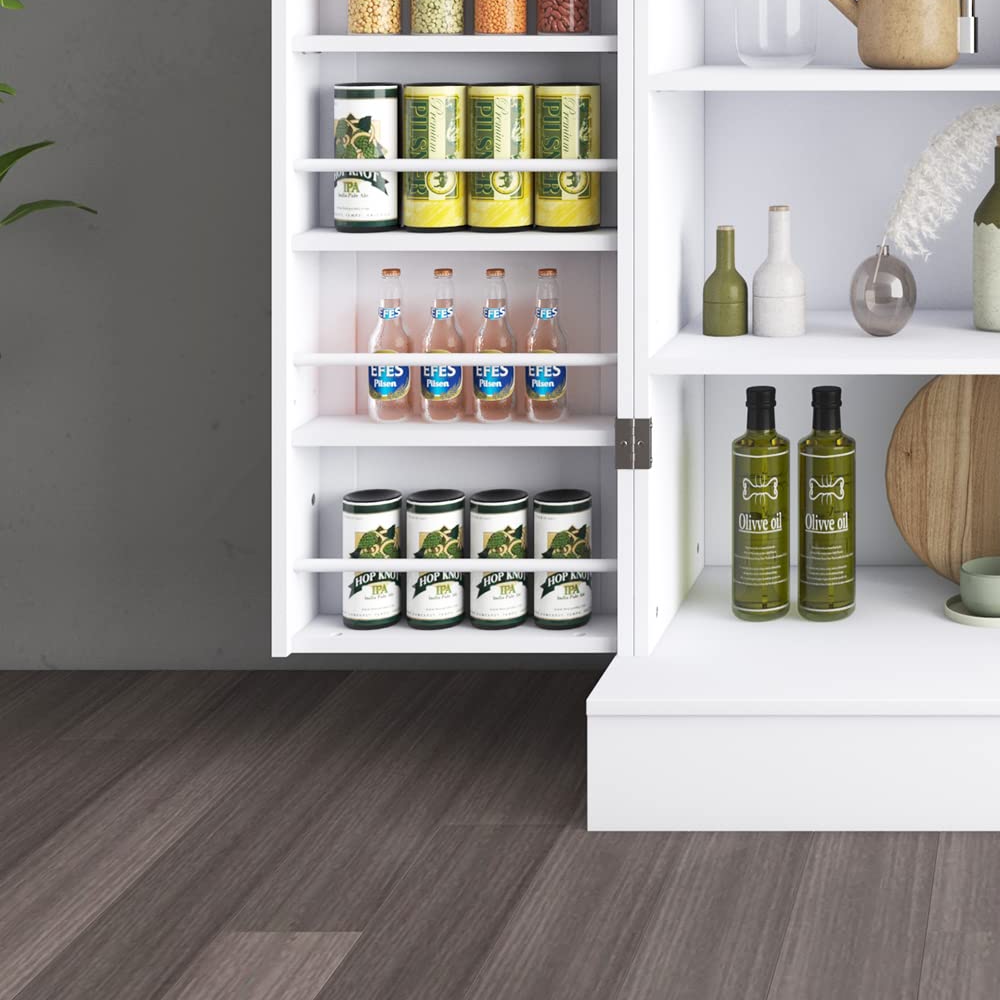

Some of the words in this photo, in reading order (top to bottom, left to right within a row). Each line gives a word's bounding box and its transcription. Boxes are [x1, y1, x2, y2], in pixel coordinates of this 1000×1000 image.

[343, 181, 360, 193] IPA
[379, 307, 401, 318] EFES
[432, 307, 453, 318] EFES
[484, 307, 506, 318] EFES
[536, 307, 558, 318] EFES
[371, 365, 404, 376] EFES
[423, 365, 456, 376] EFES
[476, 365, 508, 376] EFES
[529, 365, 561, 376] EFES
[374, 380, 397, 388] Pilsen
[427, 380, 449, 388] Pilsen
[479, 380, 502, 388] Pilsen
[532, 380, 554, 388] Pilsen
[738, 512, 769, 530] Olivve
[771, 512, 782, 530] oil
[805, 512, 836, 530] Olivve
[837, 512, 849, 530] oil
[355, 574, 376, 587] HOP
[420, 574, 440, 587] HOP
[483, 574, 504, 587] HOP
[547, 574, 568, 587] HOP
[372, 584, 388, 595] IPA
[436, 584, 452, 595] IPA
[500, 584, 516, 595] IPA
[564, 584, 580, 595] IPA
